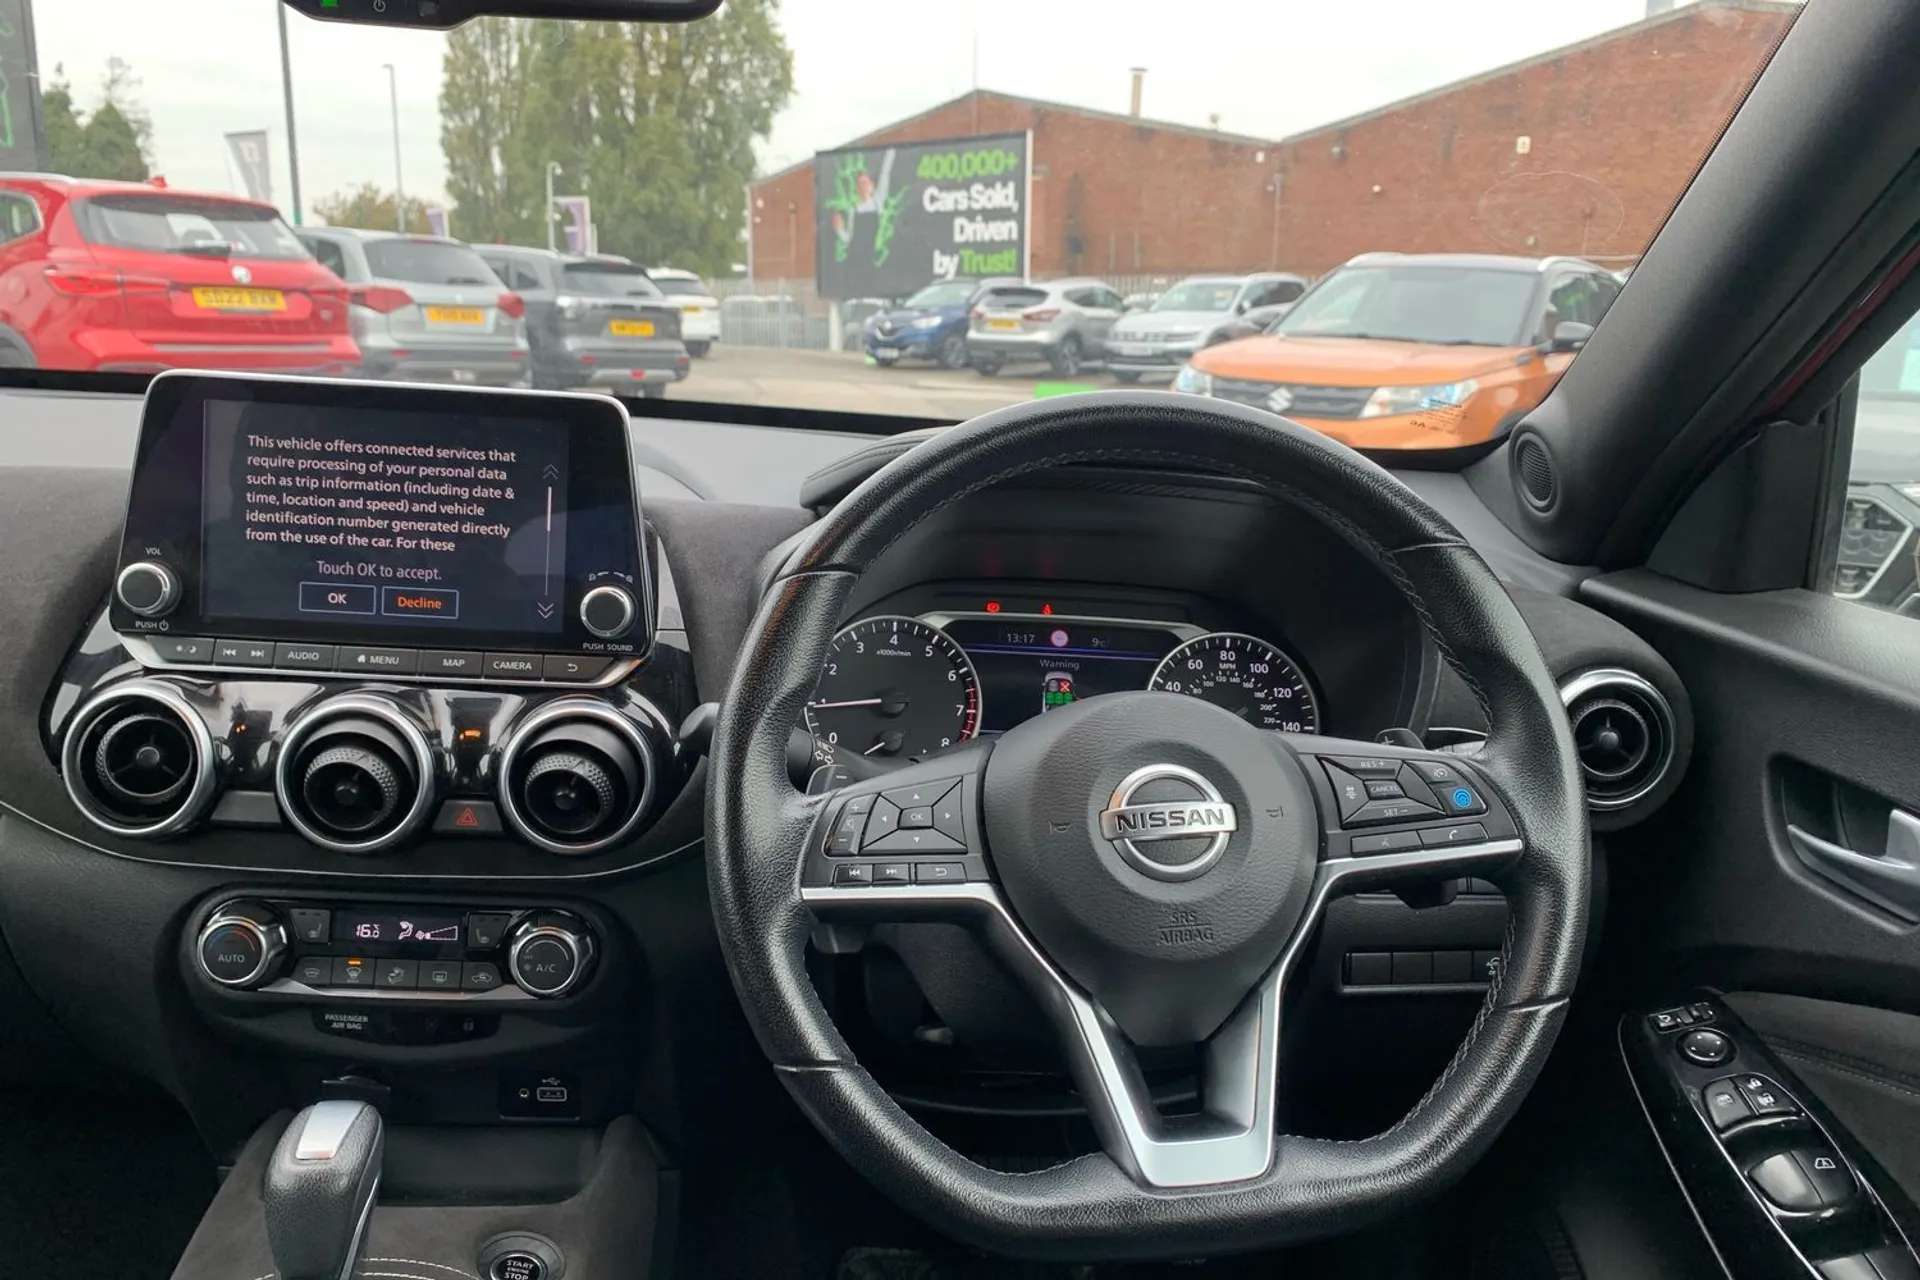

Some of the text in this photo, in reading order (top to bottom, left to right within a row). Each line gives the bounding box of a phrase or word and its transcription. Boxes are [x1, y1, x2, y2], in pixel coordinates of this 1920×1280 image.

[917, 149, 1018, 181] 400,000+
[923, 181, 1018, 213] Cars Sold,
[953, 214, 1018, 242] Driven
[933, 249, 1016, 280] by Trust!
[248, 435, 516, 462] This vehicle offers connected services that
[247, 455, 507, 480] require processing of your personal data
[246, 473, 515, 499] such as trip information (including date &
[246, 491, 485, 516] time, location and speed) and vehicle
[246, 510, 511, 538] identification number generated directly
[245, 528, 456, 552] from the use of the car. For these
[145, 547, 161, 556] VOL
[316, 560, 442, 583] Touch OK to accept.
[327, 592, 347, 605] OK
[398, 596, 442, 610] Decline
[135, 620, 157, 629] PUSH
[889, 634, 898, 645] 4
[1007, 633, 1035, 644] 13:17
[582, 642, 633, 652] PUSH SOUND
[856, 642, 865, 654] 3
[925, 646, 933, 657] 5
[288, 651, 319, 661] AUDIO
[369, 655, 400, 665] MENU
[1219, 651, 1236, 661] 80
[442, 658, 465, 668] MAP
[493, 661, 532, 670] CAMERA
[1040, 659, 1080, 671] Warning
[1187, 660, 1204, 670] 60
[1219, 662, 1236, 670] MPH
[1250, 663, 1269, 674] 100
[829, 664, 837, 676] 2
[948, 671, 957, 681] 6
[1165, 681, 1181, 692] 40
[1273, 687, 1292, 698] 120
[956, 705, 964, 716] 7
[1282, 722, 1301, 732] 140
[829, 732, 838, 744] 0
[941, 737, 950, 747] 8
[1370, 785, 1399, 793] CANCEL
[910, 813, 923, 821] OK
[1115, 808, 1225, 833] NISSAN
[1170, 911, 1197, 924] SRS
[1158, 927, 1215, 944] AIRBAG
[218, 954, 245, 963] AUTO
[536, 963, 556, 973] A/C
[325, 1014, 368, 1022] PASSENGER
[507, 1260, 533, 1269] START
[504, 1272, 529, 1280] STOP
